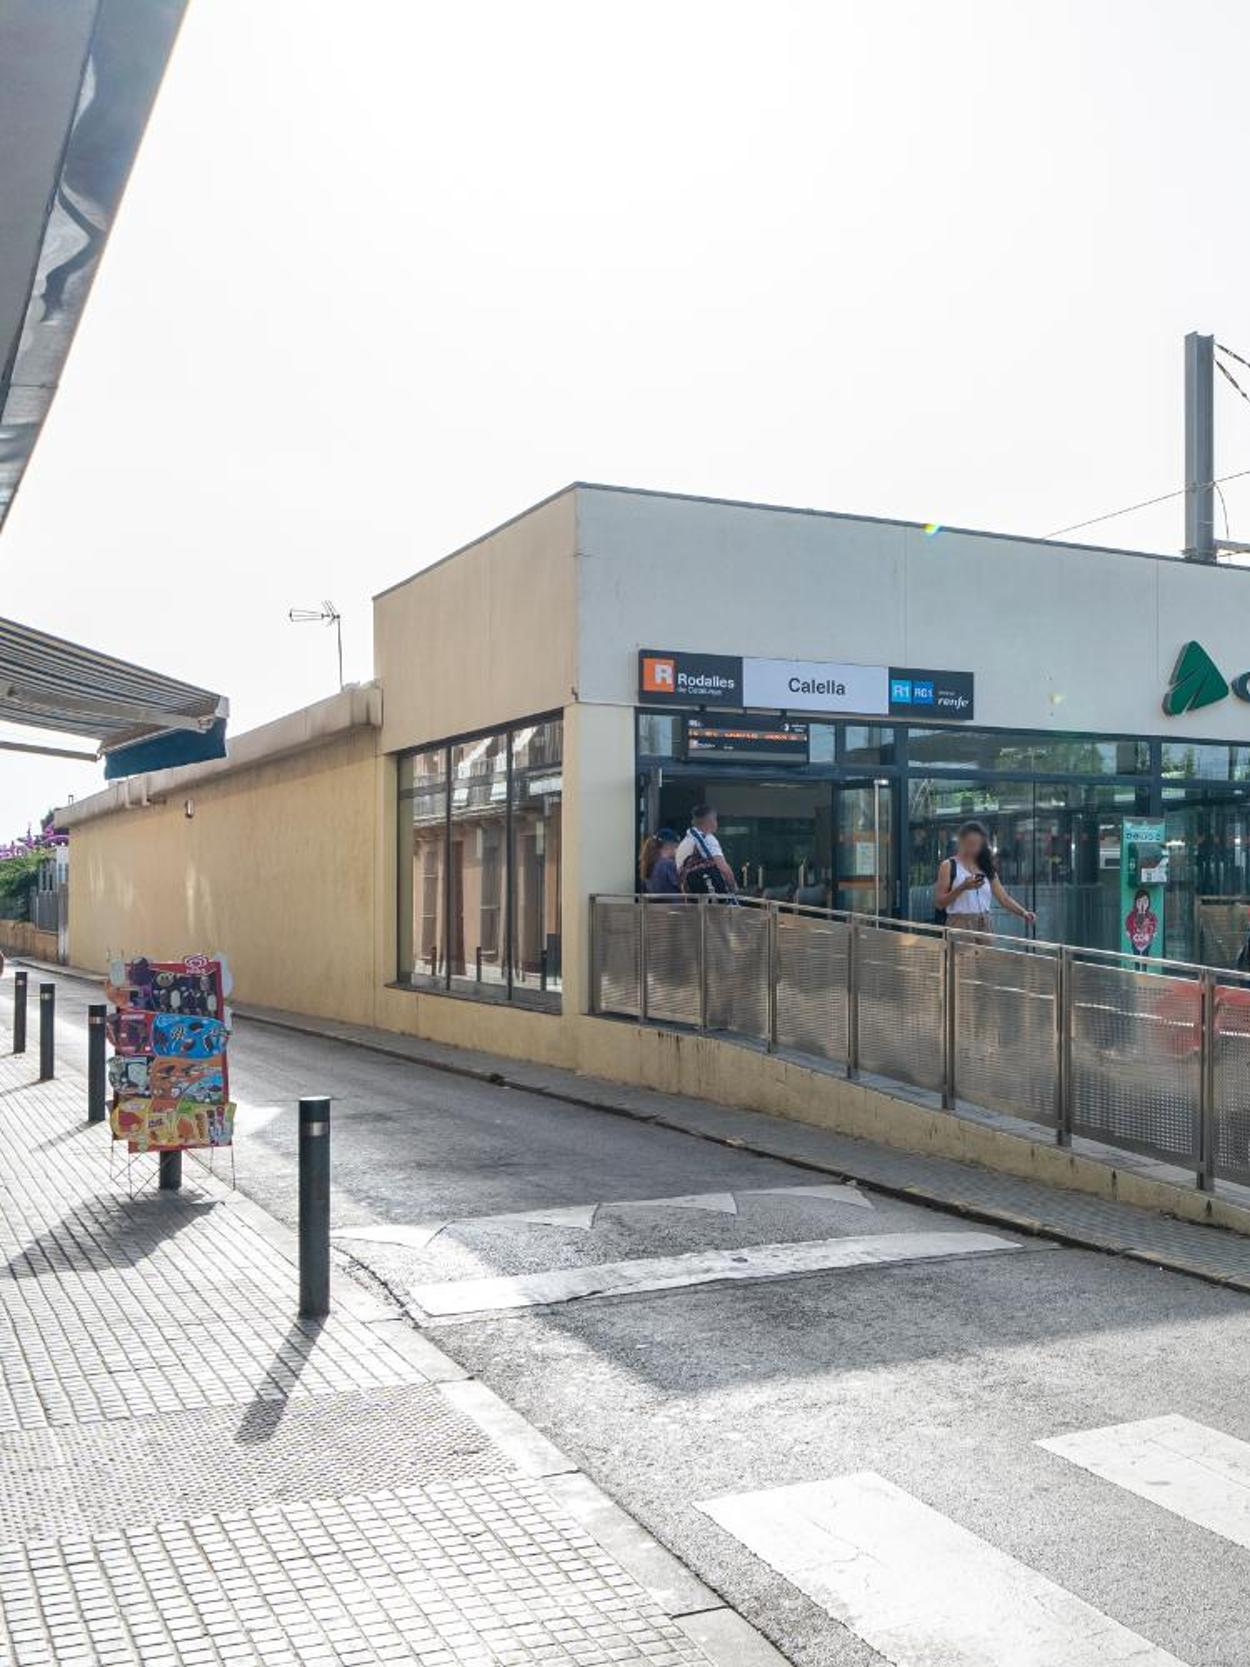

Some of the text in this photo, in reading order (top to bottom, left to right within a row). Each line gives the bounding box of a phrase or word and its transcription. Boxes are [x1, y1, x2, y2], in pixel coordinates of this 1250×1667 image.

[788, 677, 846, 696] Calella
[895, 685, 909, 697] R1
[937, 695, 969, 710] renfe
